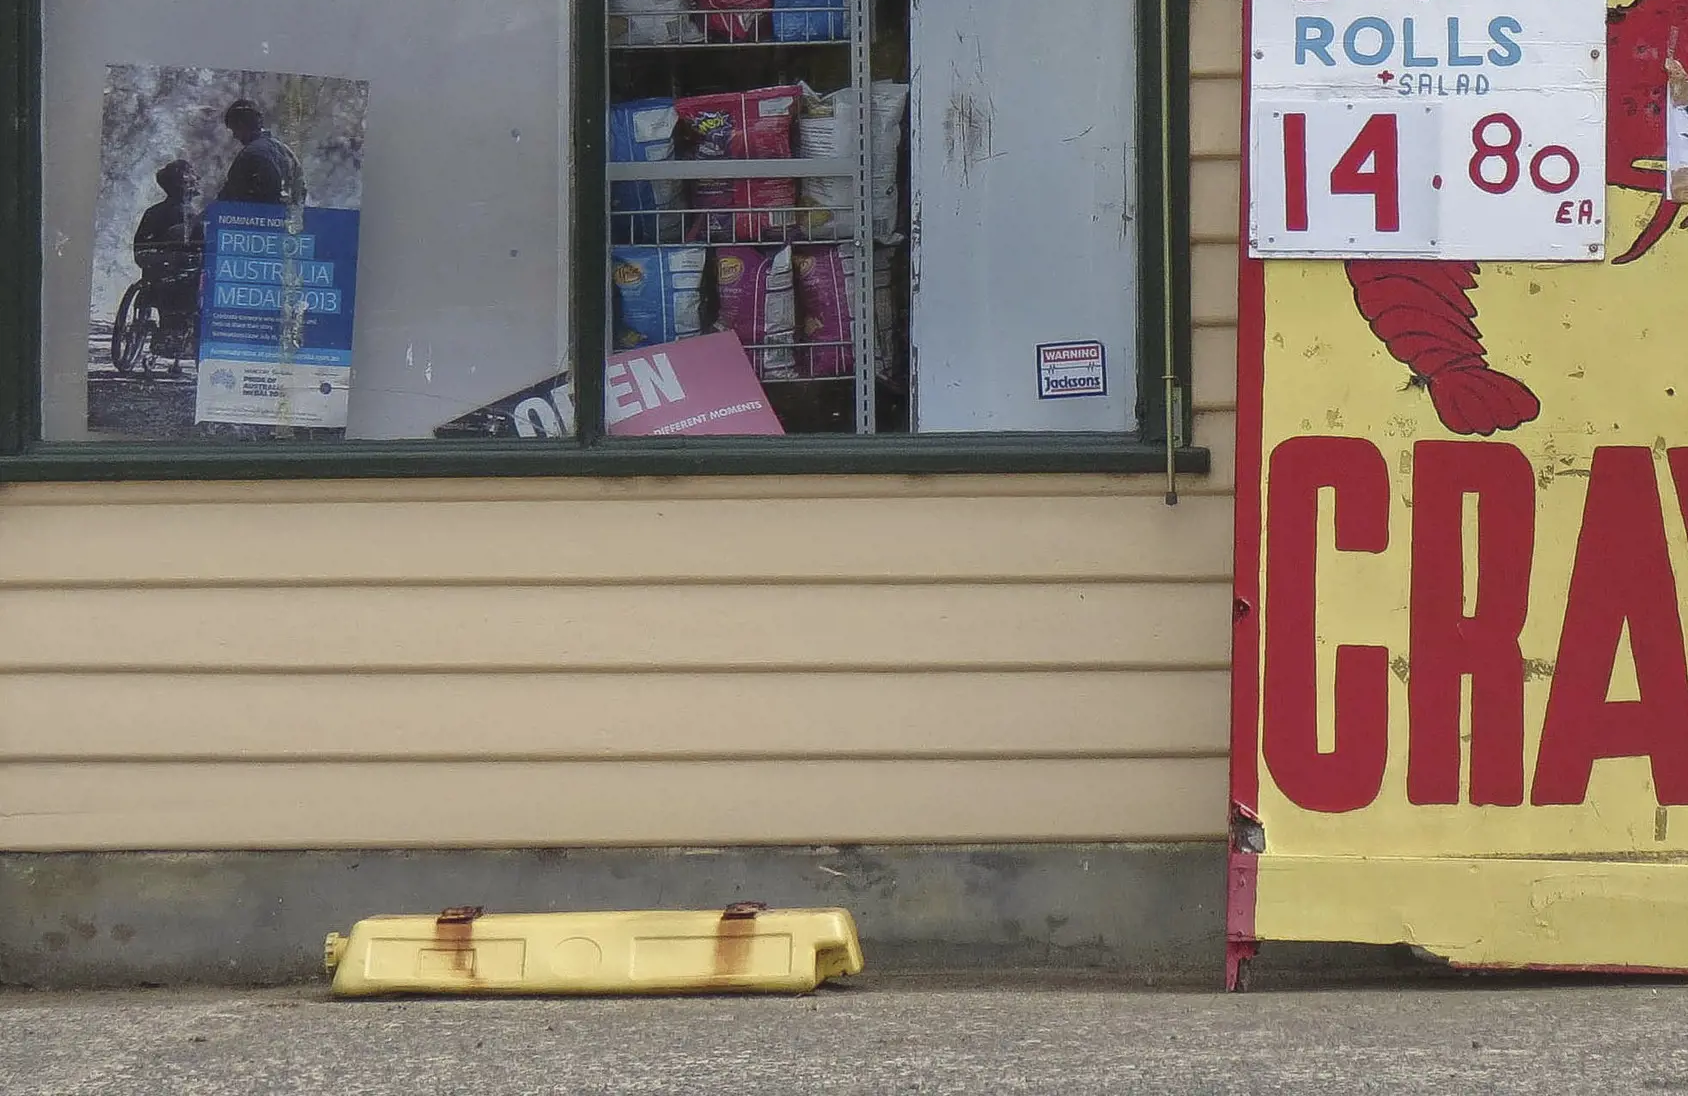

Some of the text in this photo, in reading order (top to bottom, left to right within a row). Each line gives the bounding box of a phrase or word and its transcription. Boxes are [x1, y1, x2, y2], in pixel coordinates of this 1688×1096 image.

[1294, 15, 1524, 68] ROLLS
[1398, 73, 1490, 96] SALAD
[218, 215, 266, 227] NOMINATE
[220, 232, 313, 256] PRIDE OF
[218, 258, 330, 285] AUSTRLIA
[1044, 348, 1098, 361] WARNING
[1044, 375, 1101, 393] Jacksons
[652, 400, 763, 436] DIFFERENT MOMENTS
